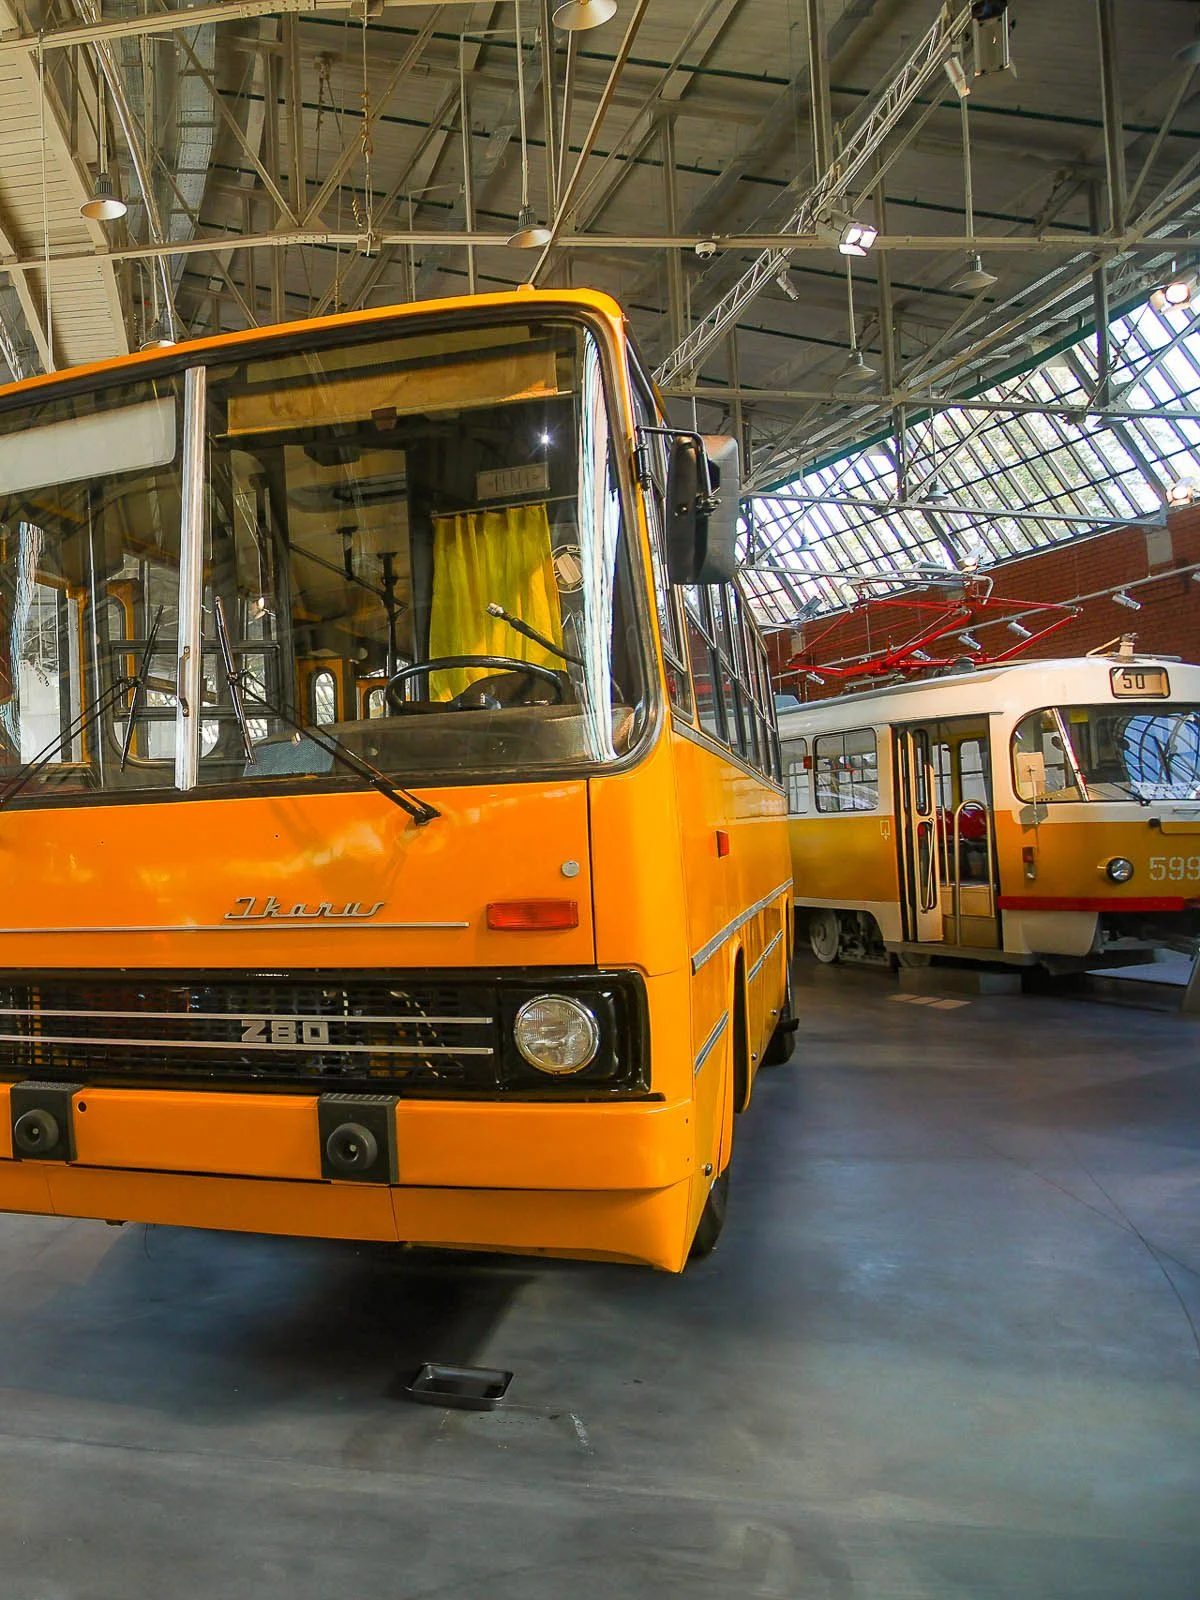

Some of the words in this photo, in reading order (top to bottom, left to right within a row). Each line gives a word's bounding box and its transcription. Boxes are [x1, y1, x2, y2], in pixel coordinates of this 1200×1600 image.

[1122, 673, 1145, 689] 50
[1150, 856, 1200, 880] 599
[224, 896, 385, 920] Ikarus
